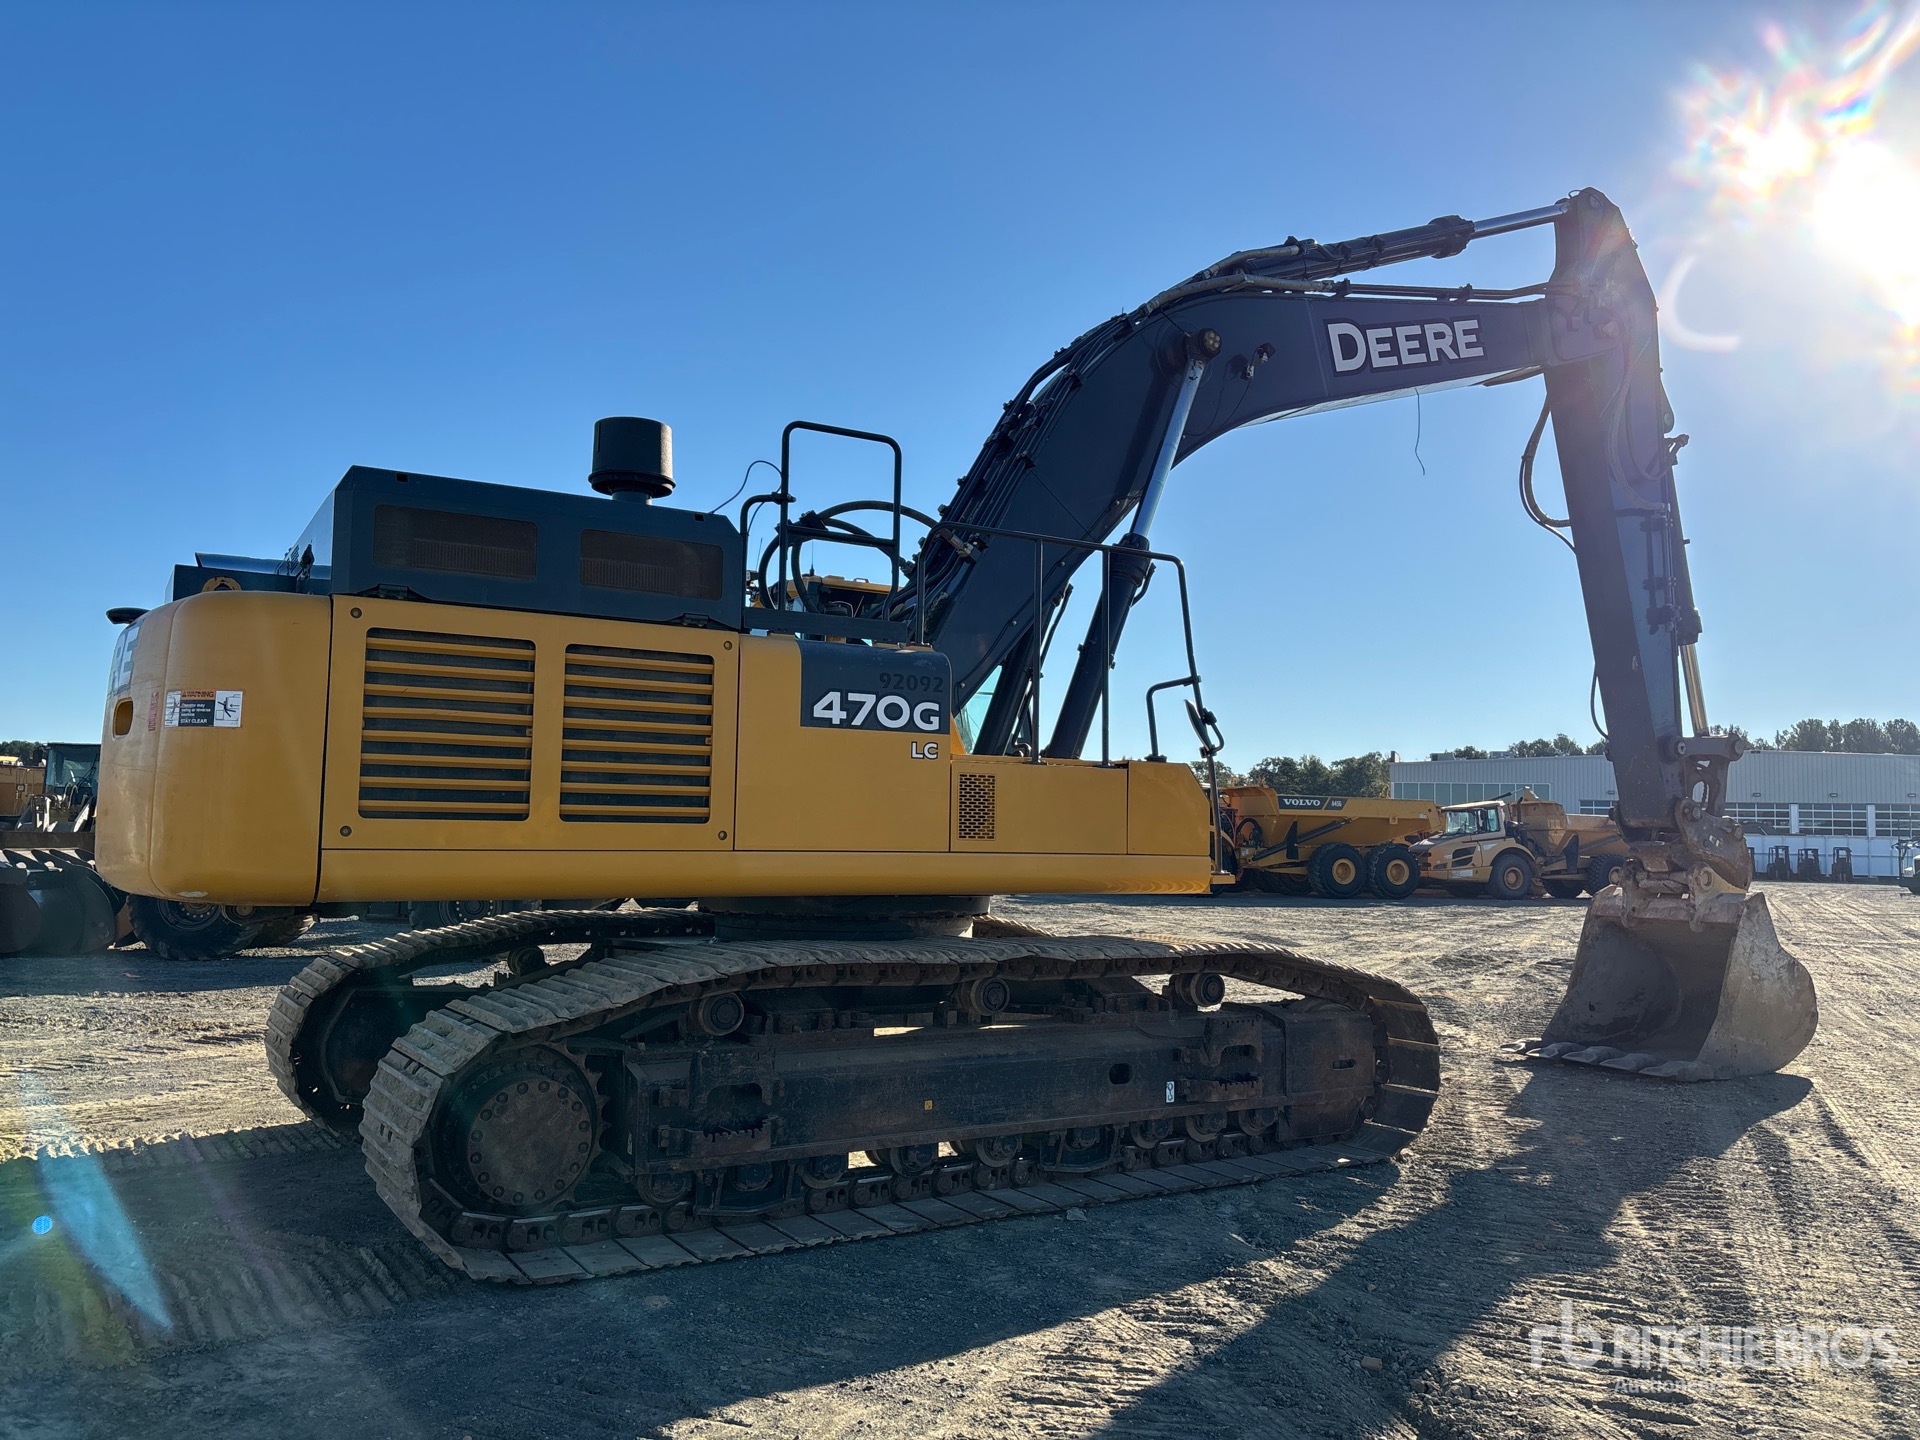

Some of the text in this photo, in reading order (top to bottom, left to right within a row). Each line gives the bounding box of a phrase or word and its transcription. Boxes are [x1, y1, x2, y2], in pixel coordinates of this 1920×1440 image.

[1327, 319, 1484, 372] DEERE
[879, 672, 944, 693] 92092
[813, 691, 940, 731] 470G
[911, 741, 939, 760] LC
[1283, 798, 1321, 806] VOLVO
